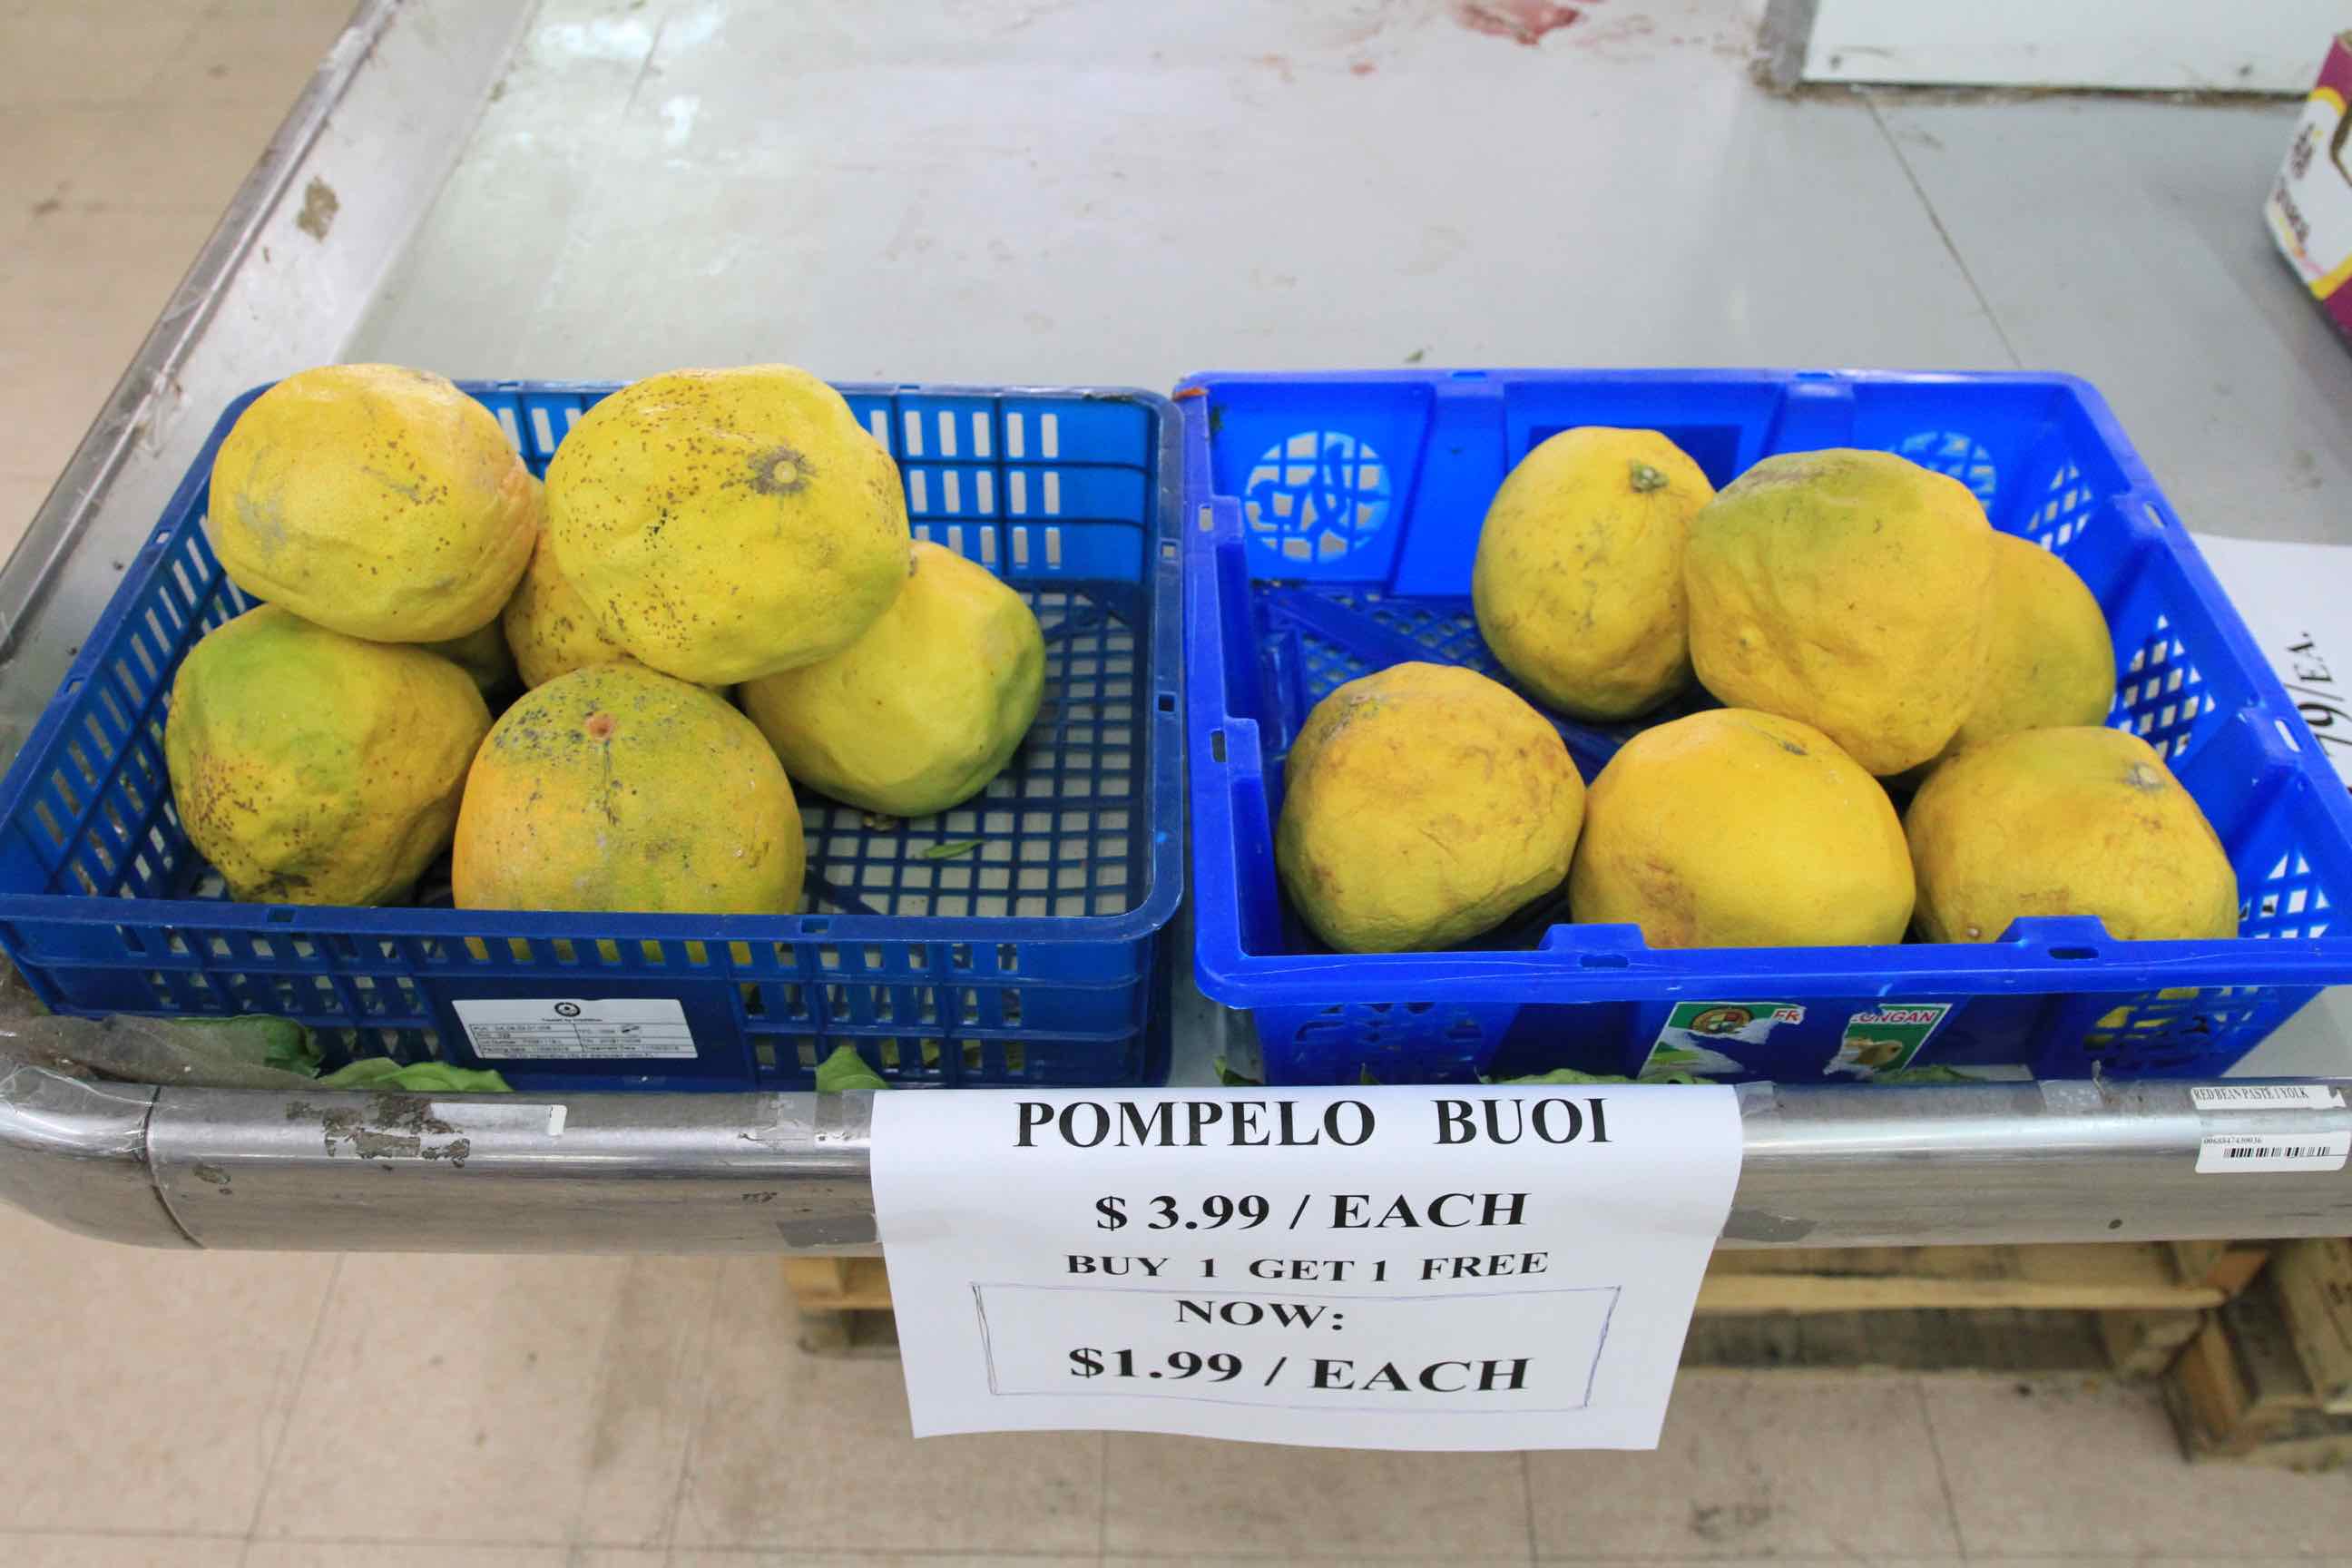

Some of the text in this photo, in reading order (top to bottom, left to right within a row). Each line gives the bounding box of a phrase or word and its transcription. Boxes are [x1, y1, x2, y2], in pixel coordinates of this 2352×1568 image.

[1014, 1098, 1613, 1148] POMPELO BUOI
[1095, 1192, 1533, 1231] $ 3.99 / EACH
[1066, 1251, 1551, 1282] BUY 1 GET 1 FREE
[1175, 1299, 1345, 1331] NOW:
[1068, 1347, 1534, 1392] $1.99 / EACH
